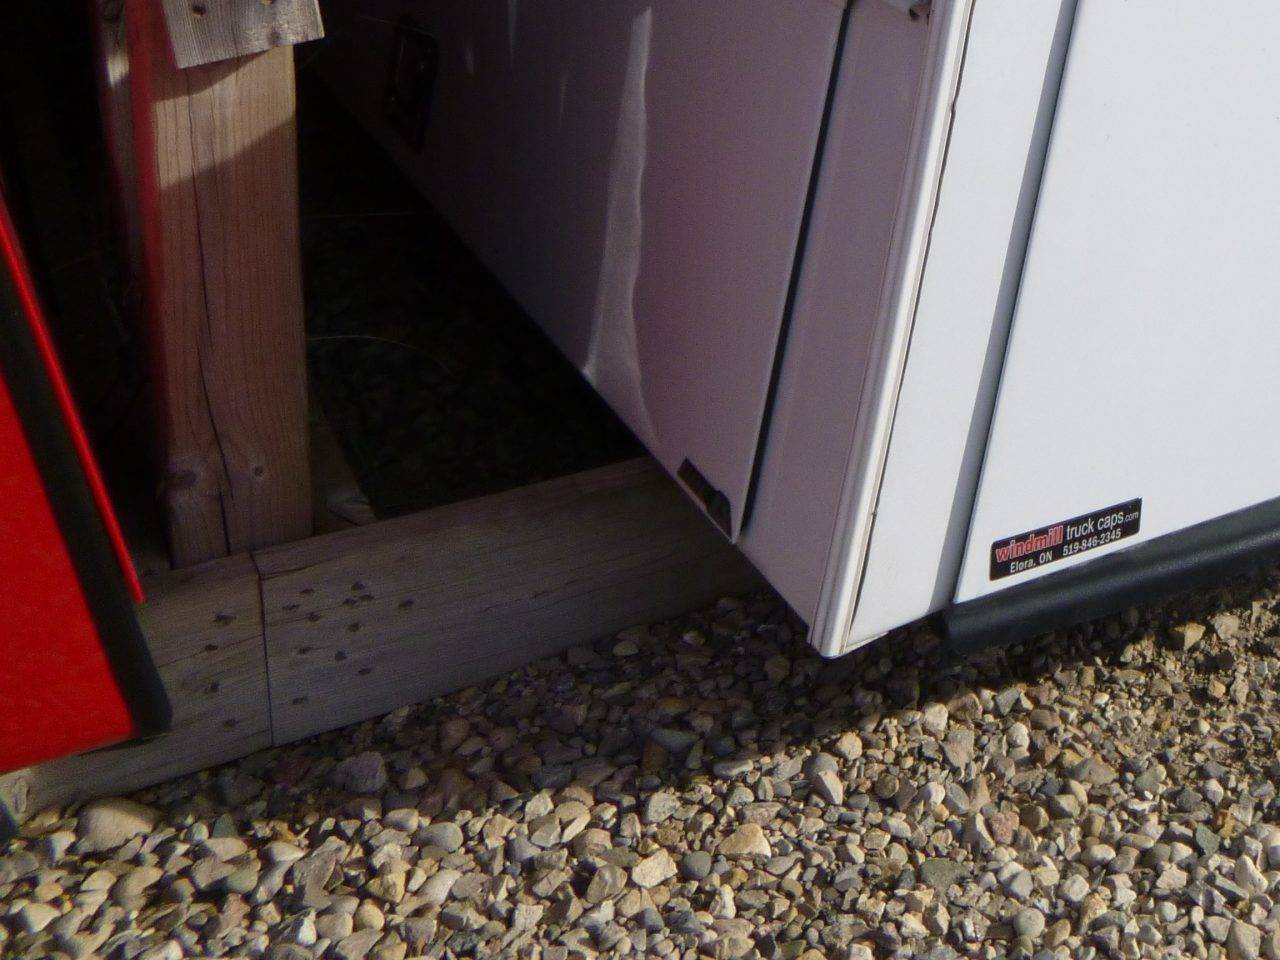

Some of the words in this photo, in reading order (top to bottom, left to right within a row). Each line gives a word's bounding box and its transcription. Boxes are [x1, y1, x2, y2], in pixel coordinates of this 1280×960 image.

[996, 525, 1064, 563] windmill
[1066, 518, 1095, 540] truck
[1039, 550, 1053, 564] ON
[1062, 528, 1122, 556] 519-846-2345
